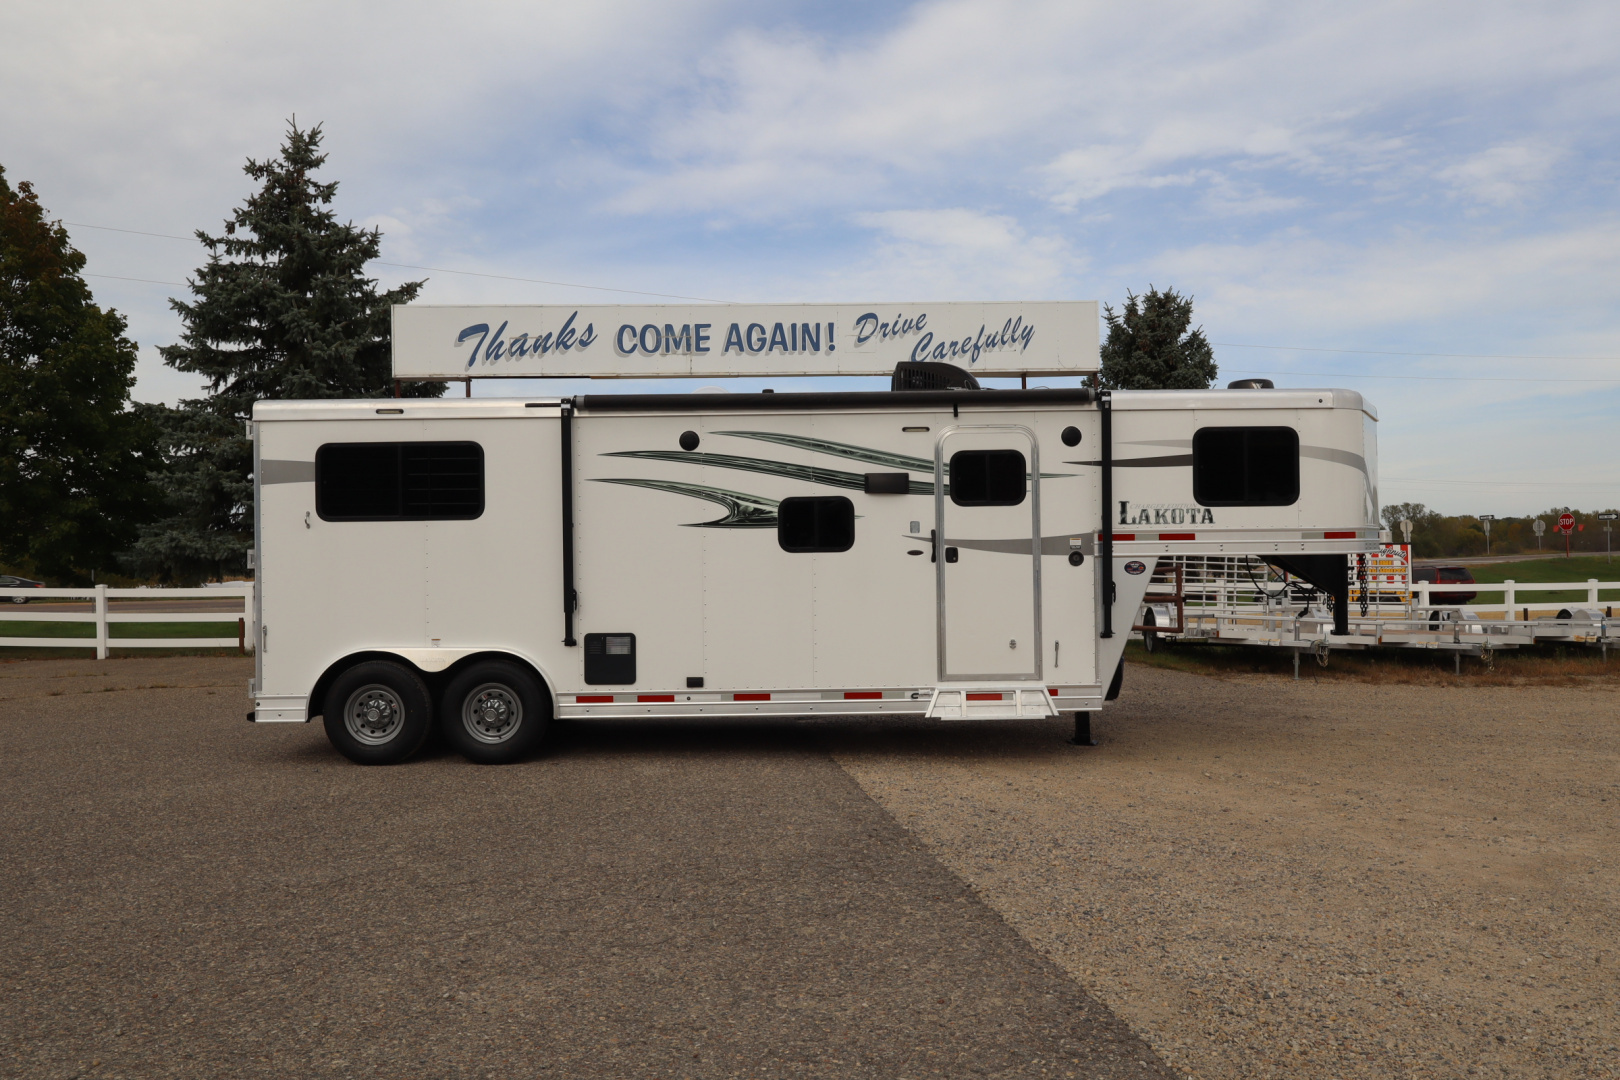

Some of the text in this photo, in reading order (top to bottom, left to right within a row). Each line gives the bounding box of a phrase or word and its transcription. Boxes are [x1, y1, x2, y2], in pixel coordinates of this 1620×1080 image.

[458, 310, 836, 367] Thanks COME AGAIN!
[855, 312, 927, 343] Drive
[911, 315, 1035, 363] Carefully
[1118, 501, 1216, 525] LAKOTA
[1559, 518, 1574, 526] STOP
